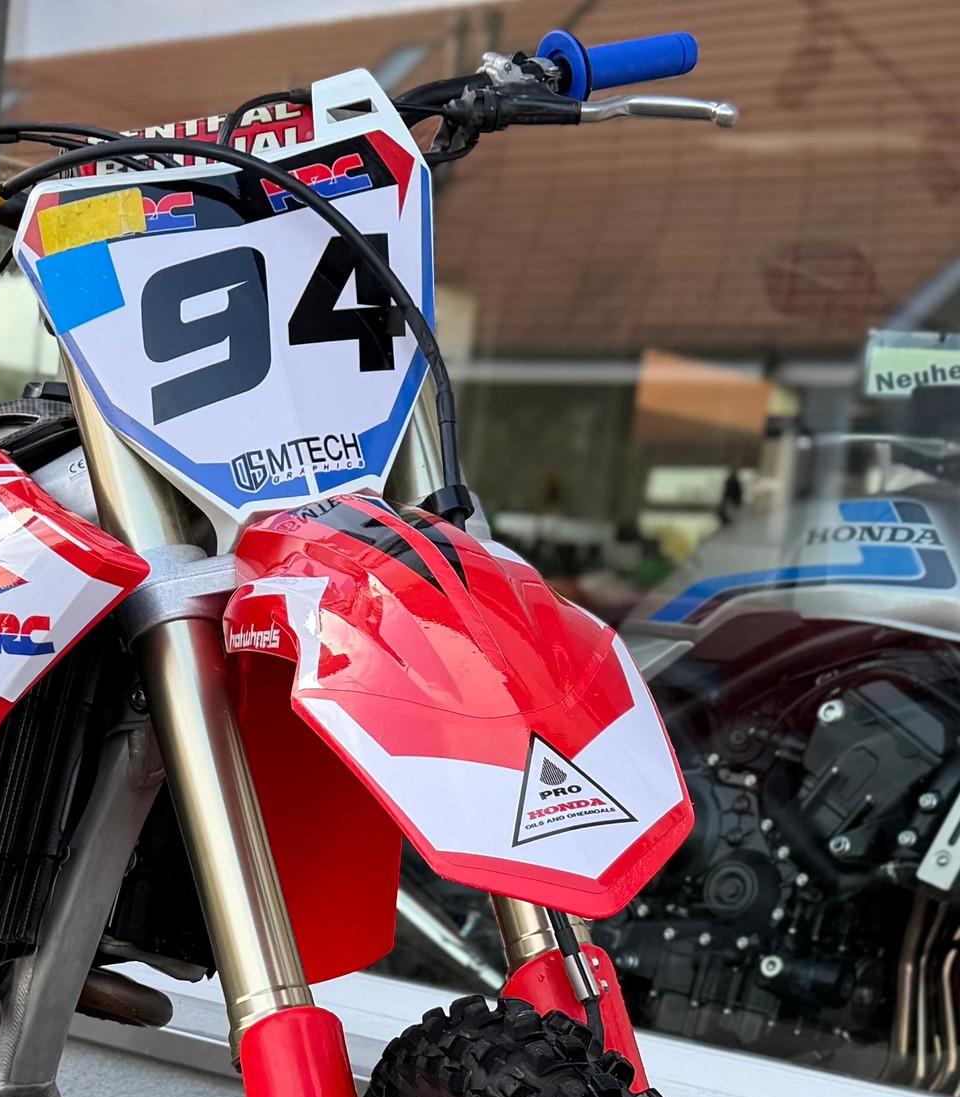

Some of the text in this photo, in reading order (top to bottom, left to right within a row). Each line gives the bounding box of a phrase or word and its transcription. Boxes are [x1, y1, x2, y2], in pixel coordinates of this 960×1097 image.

[273, 461, 364, 483] GRAPHICS
[807, 525, 944, 546] HONDA
[539, 785, 582, 800] PRO
[527, 798, 607, 820] HONDA
[525, 820, 544, 830] OILS
[546, 815, 565, 824] AND
